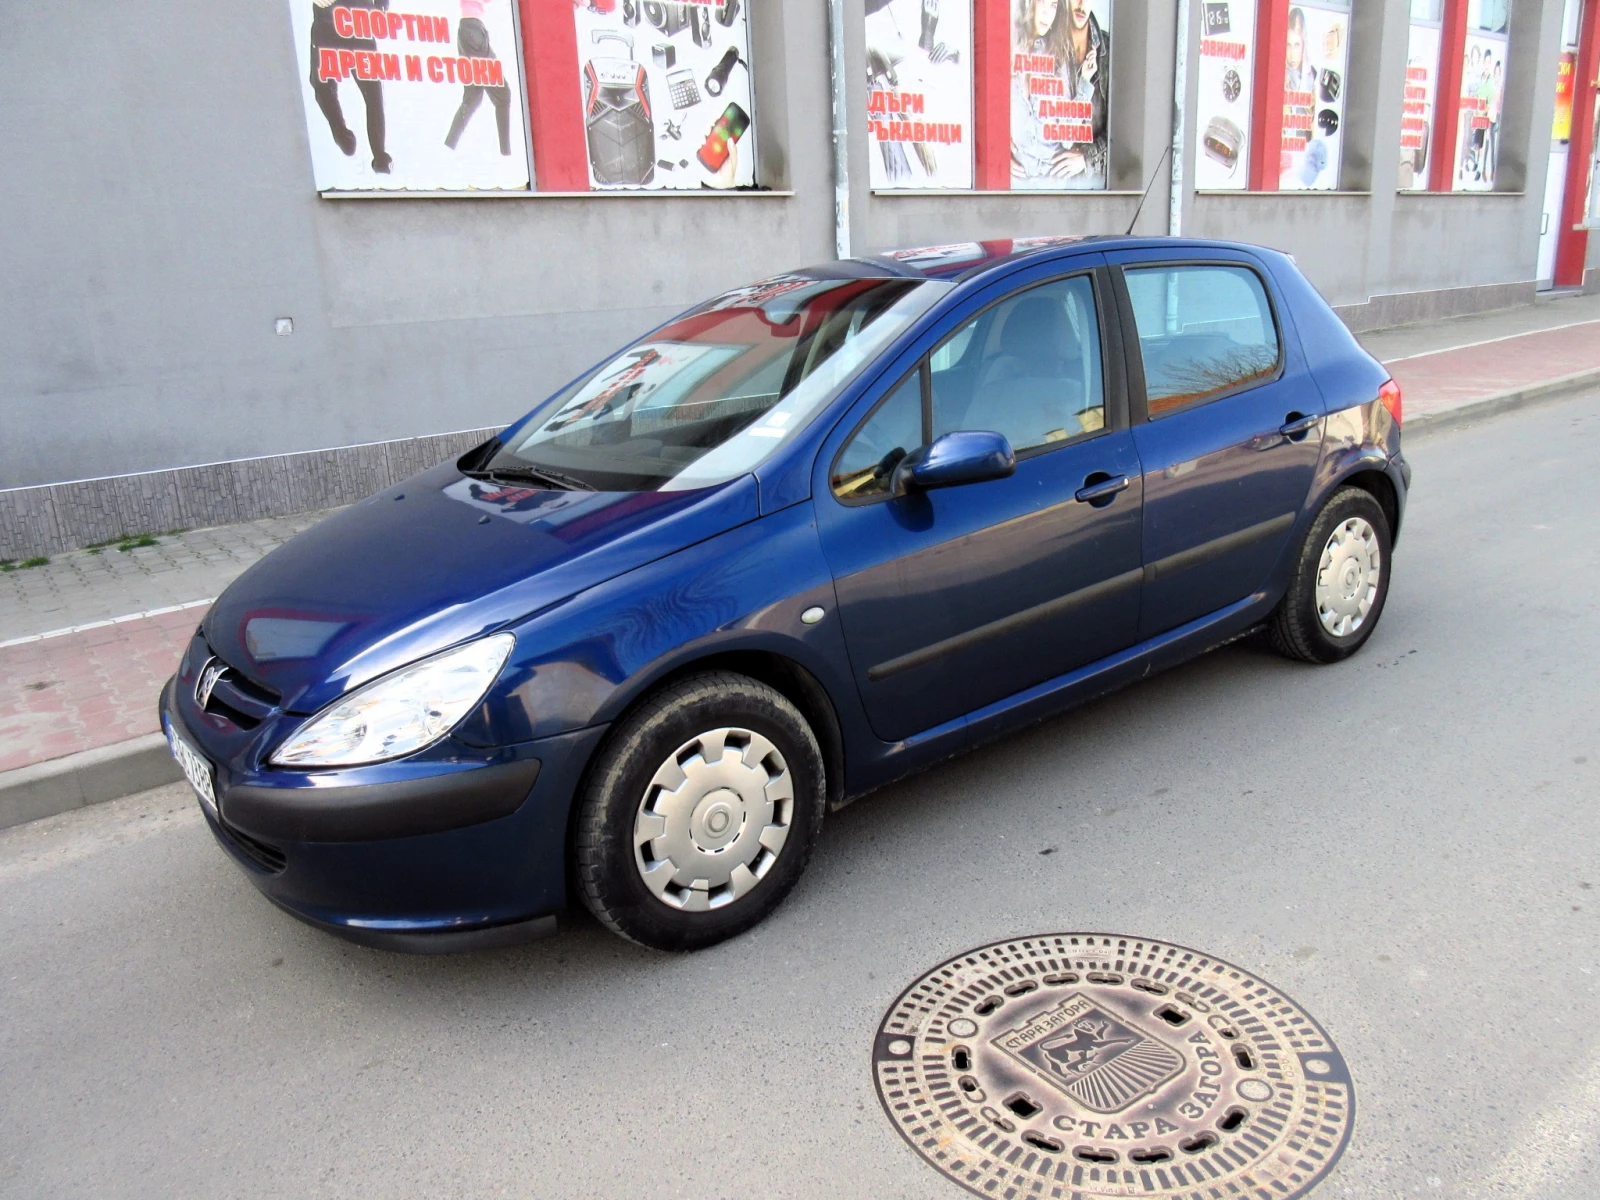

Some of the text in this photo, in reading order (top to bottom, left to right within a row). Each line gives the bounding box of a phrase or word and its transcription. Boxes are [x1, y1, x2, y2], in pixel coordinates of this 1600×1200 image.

[334, 8, 451, 44] СПОРТНИ
[318, 49, 504, 86] ДРЕХИ И СТОКИ
[1013, 54, 1054, 73] ДЪНКИ
[1030, 77, 1064, 97] ЯКЕТА
[1038, 100, 1092, 119] ДЪНКОВИ
[1043, 123, 1093, 142] ОБЛЕКЛА
[1005, 999, 1091, 1048] СТАРА ЗАГОРА
[1053, 1030, 1223, 1140] СТАРА ЗАГОРА
